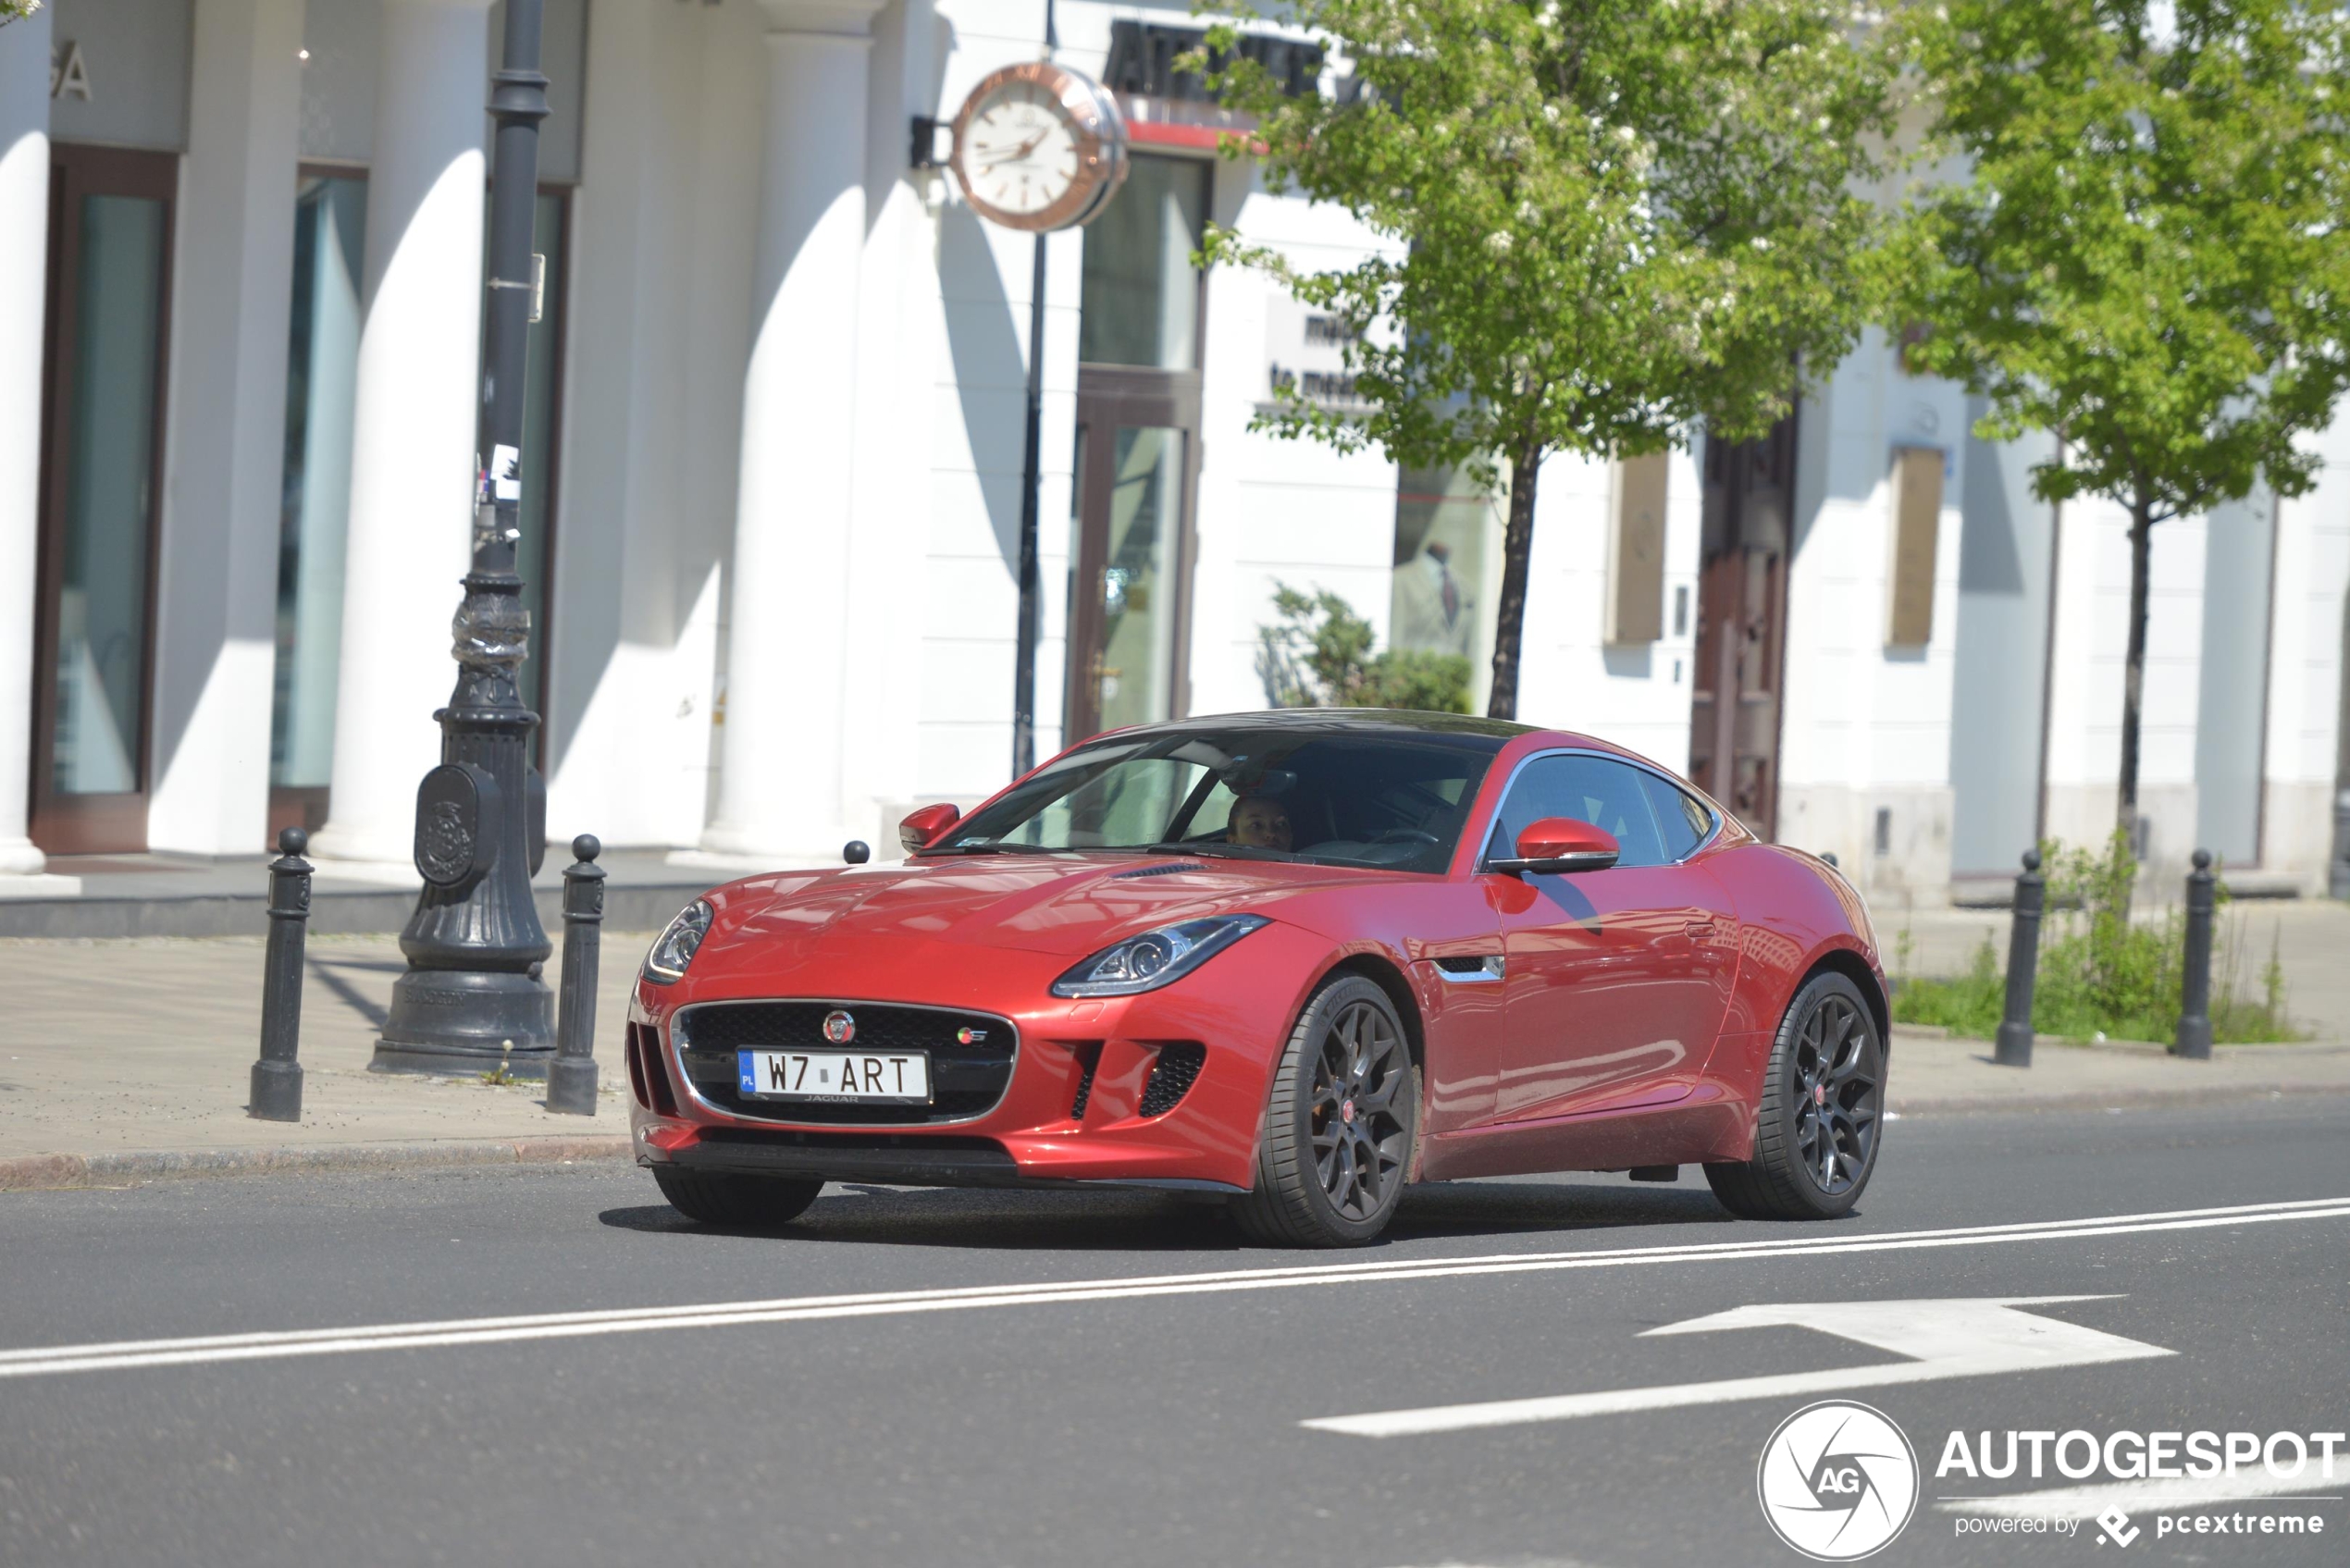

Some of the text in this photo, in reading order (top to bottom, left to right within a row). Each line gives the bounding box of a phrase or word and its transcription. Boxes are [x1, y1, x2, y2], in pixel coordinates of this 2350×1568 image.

[769, 1055, 909, 1093] W7 ART
[742, 1075, 753, 1085] PL
[805, 1094, 859, 1103] JAGUAR
